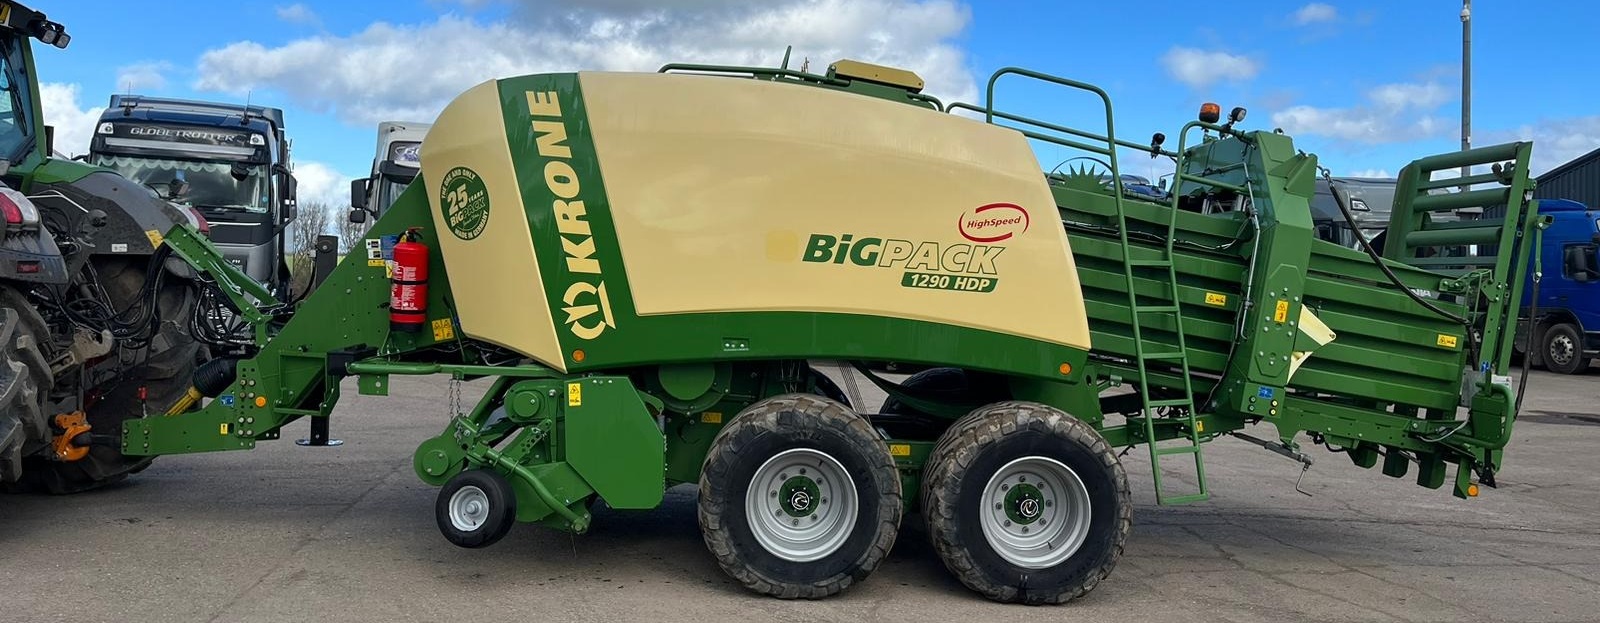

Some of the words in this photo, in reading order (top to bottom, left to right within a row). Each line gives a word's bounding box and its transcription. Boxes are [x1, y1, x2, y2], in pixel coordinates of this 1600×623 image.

[130, 127, 235, 142] GLOBETROTTER
[444, 173, 452, 186] ONE
[451, 169, 462, 177] AND
[462, 169, 476, 180] ONLY
[525, 90, 602, 274] KRONE
[447, 183, 468, 215] 25
[468, 190, 484, 203] YEARS
[454, 228, 468, 239] MADE
[468, 231, 473, 239] IN
[472, 209, 489, 237] GERMANY
[966, 215, 1022, 230] HighSpeed
[910, 273, 950, 289] 1290
[953, 276, 991, 291] HDP
[1410, 288, 1432, 297] NIA
